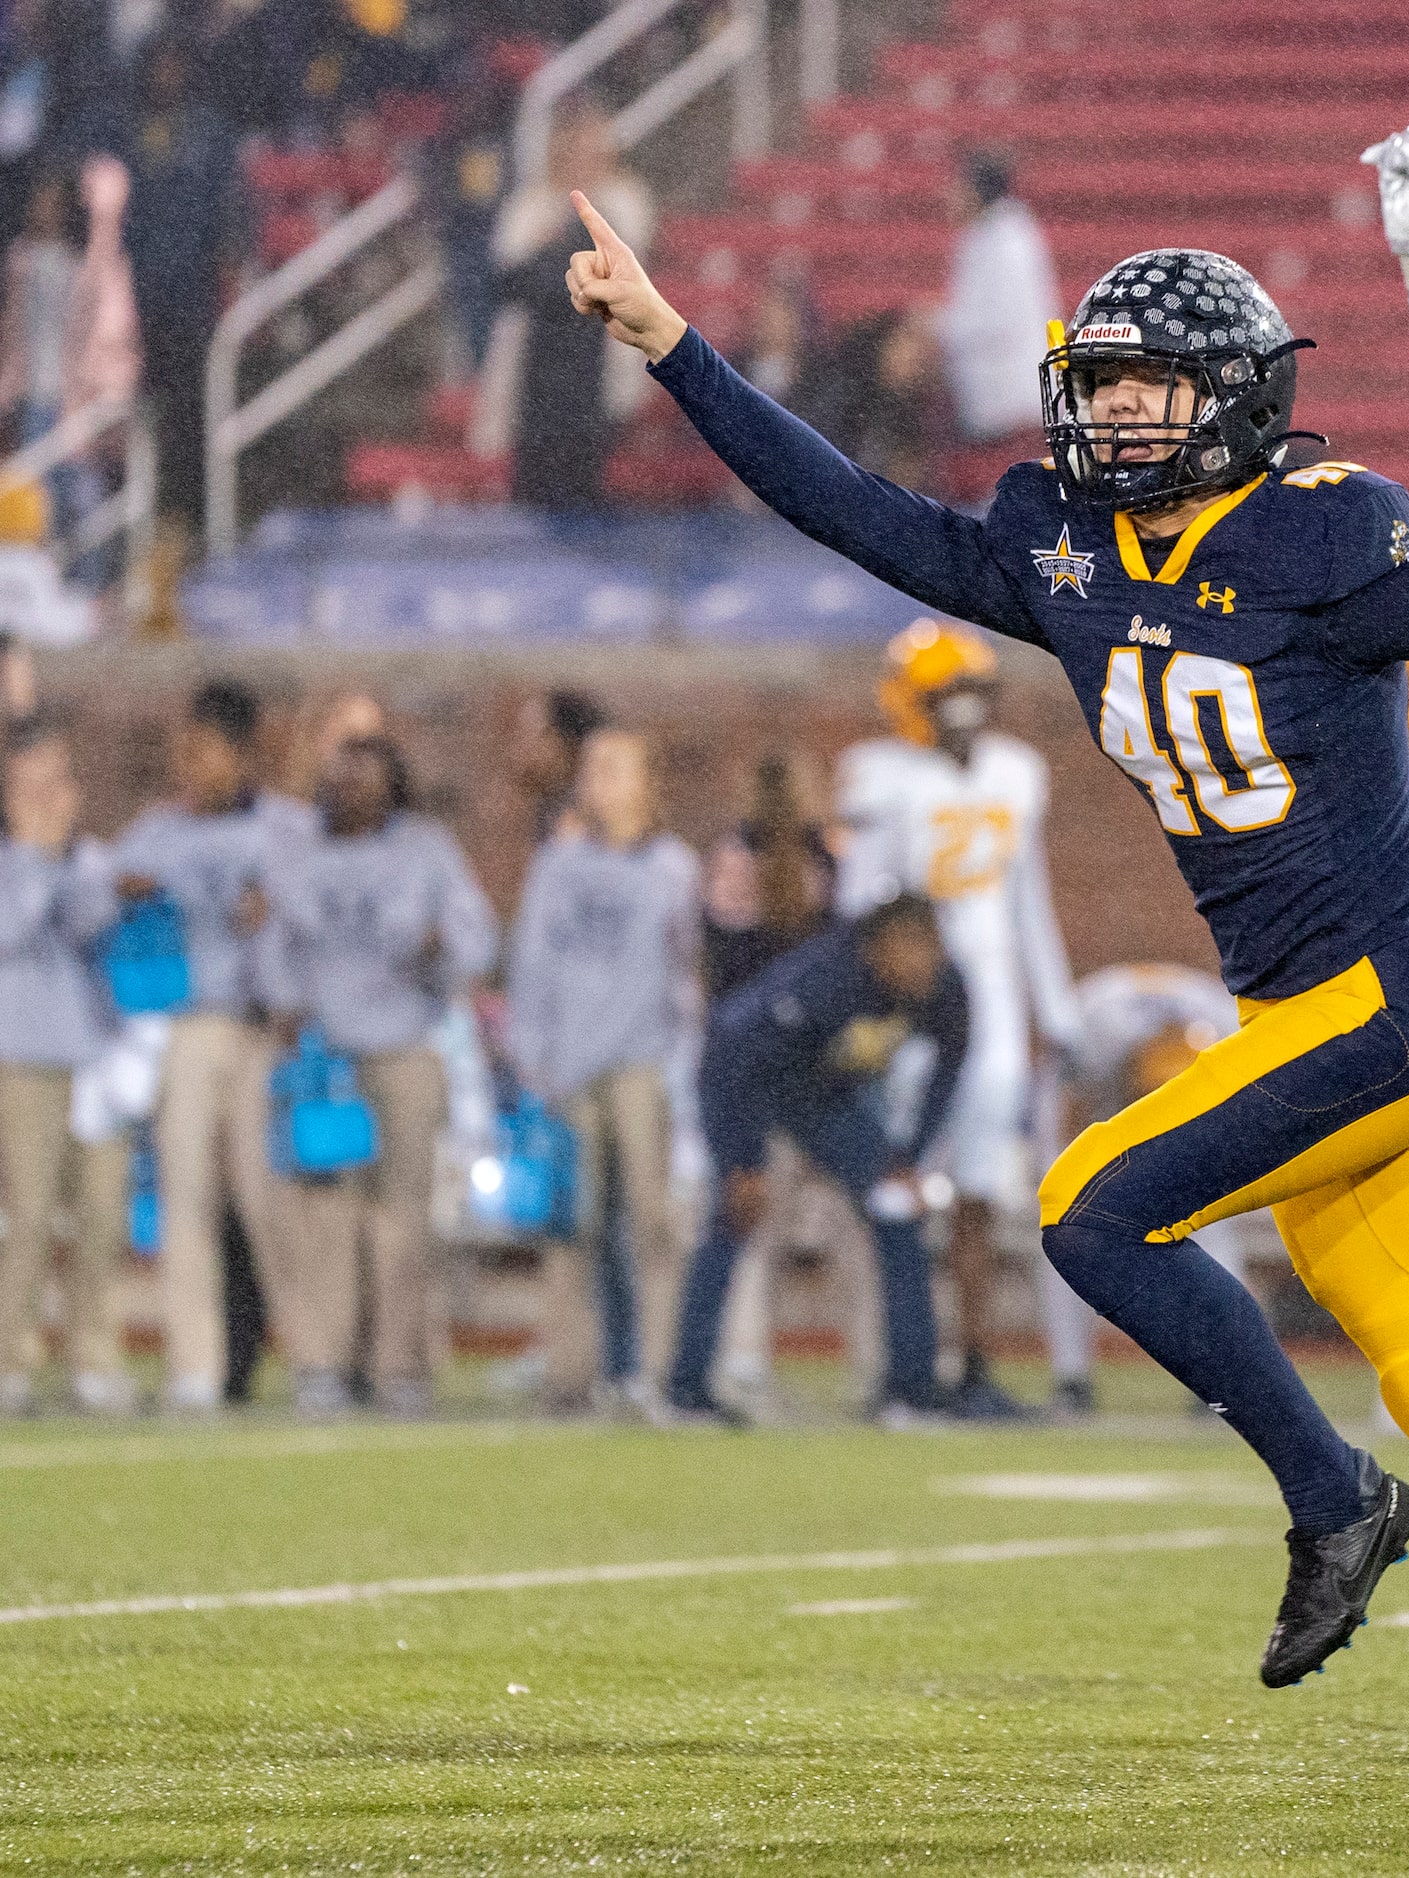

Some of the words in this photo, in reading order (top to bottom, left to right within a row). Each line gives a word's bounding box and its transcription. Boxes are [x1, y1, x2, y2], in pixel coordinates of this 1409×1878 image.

[1161, 292, 1182, 310] PRIDE
[1144, 308, 1166, 324] PRIDE
[1081, 326, 1132, 340] Riddell
[1165, 319, 1186, 336] PRIDE
[1128, 615, 1171, 647] Scots
[1100, 646, 1297, 836] 40
